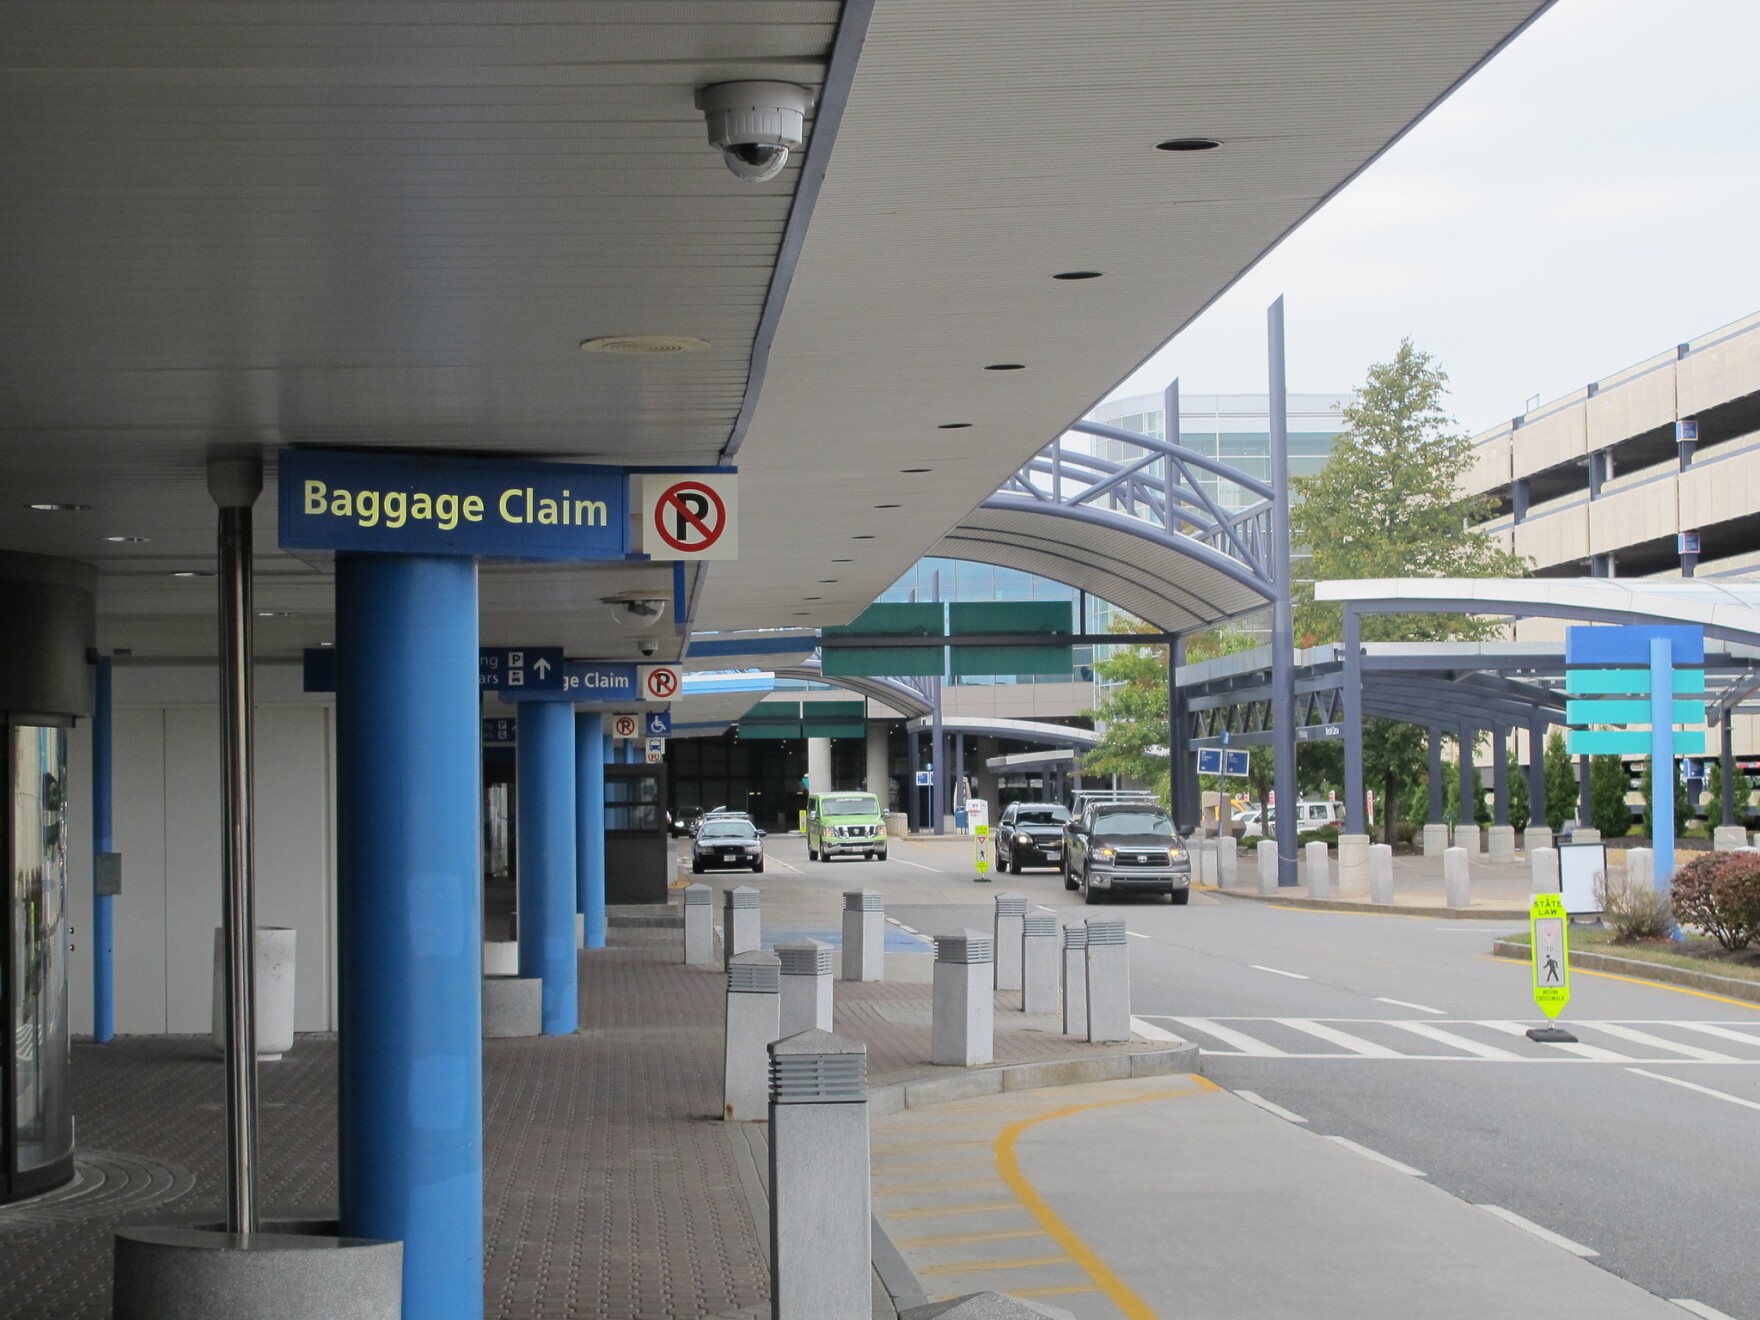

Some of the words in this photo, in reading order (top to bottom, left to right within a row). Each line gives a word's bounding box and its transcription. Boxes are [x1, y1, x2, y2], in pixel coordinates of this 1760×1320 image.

[304, 479, 485, 531] Baggage
[499, 487, 608, 527] Claim
[479, 673, 500, 684] ars
[584, 672, 629, 688] Claim
[1533, 900, 1562, 908] STATE
